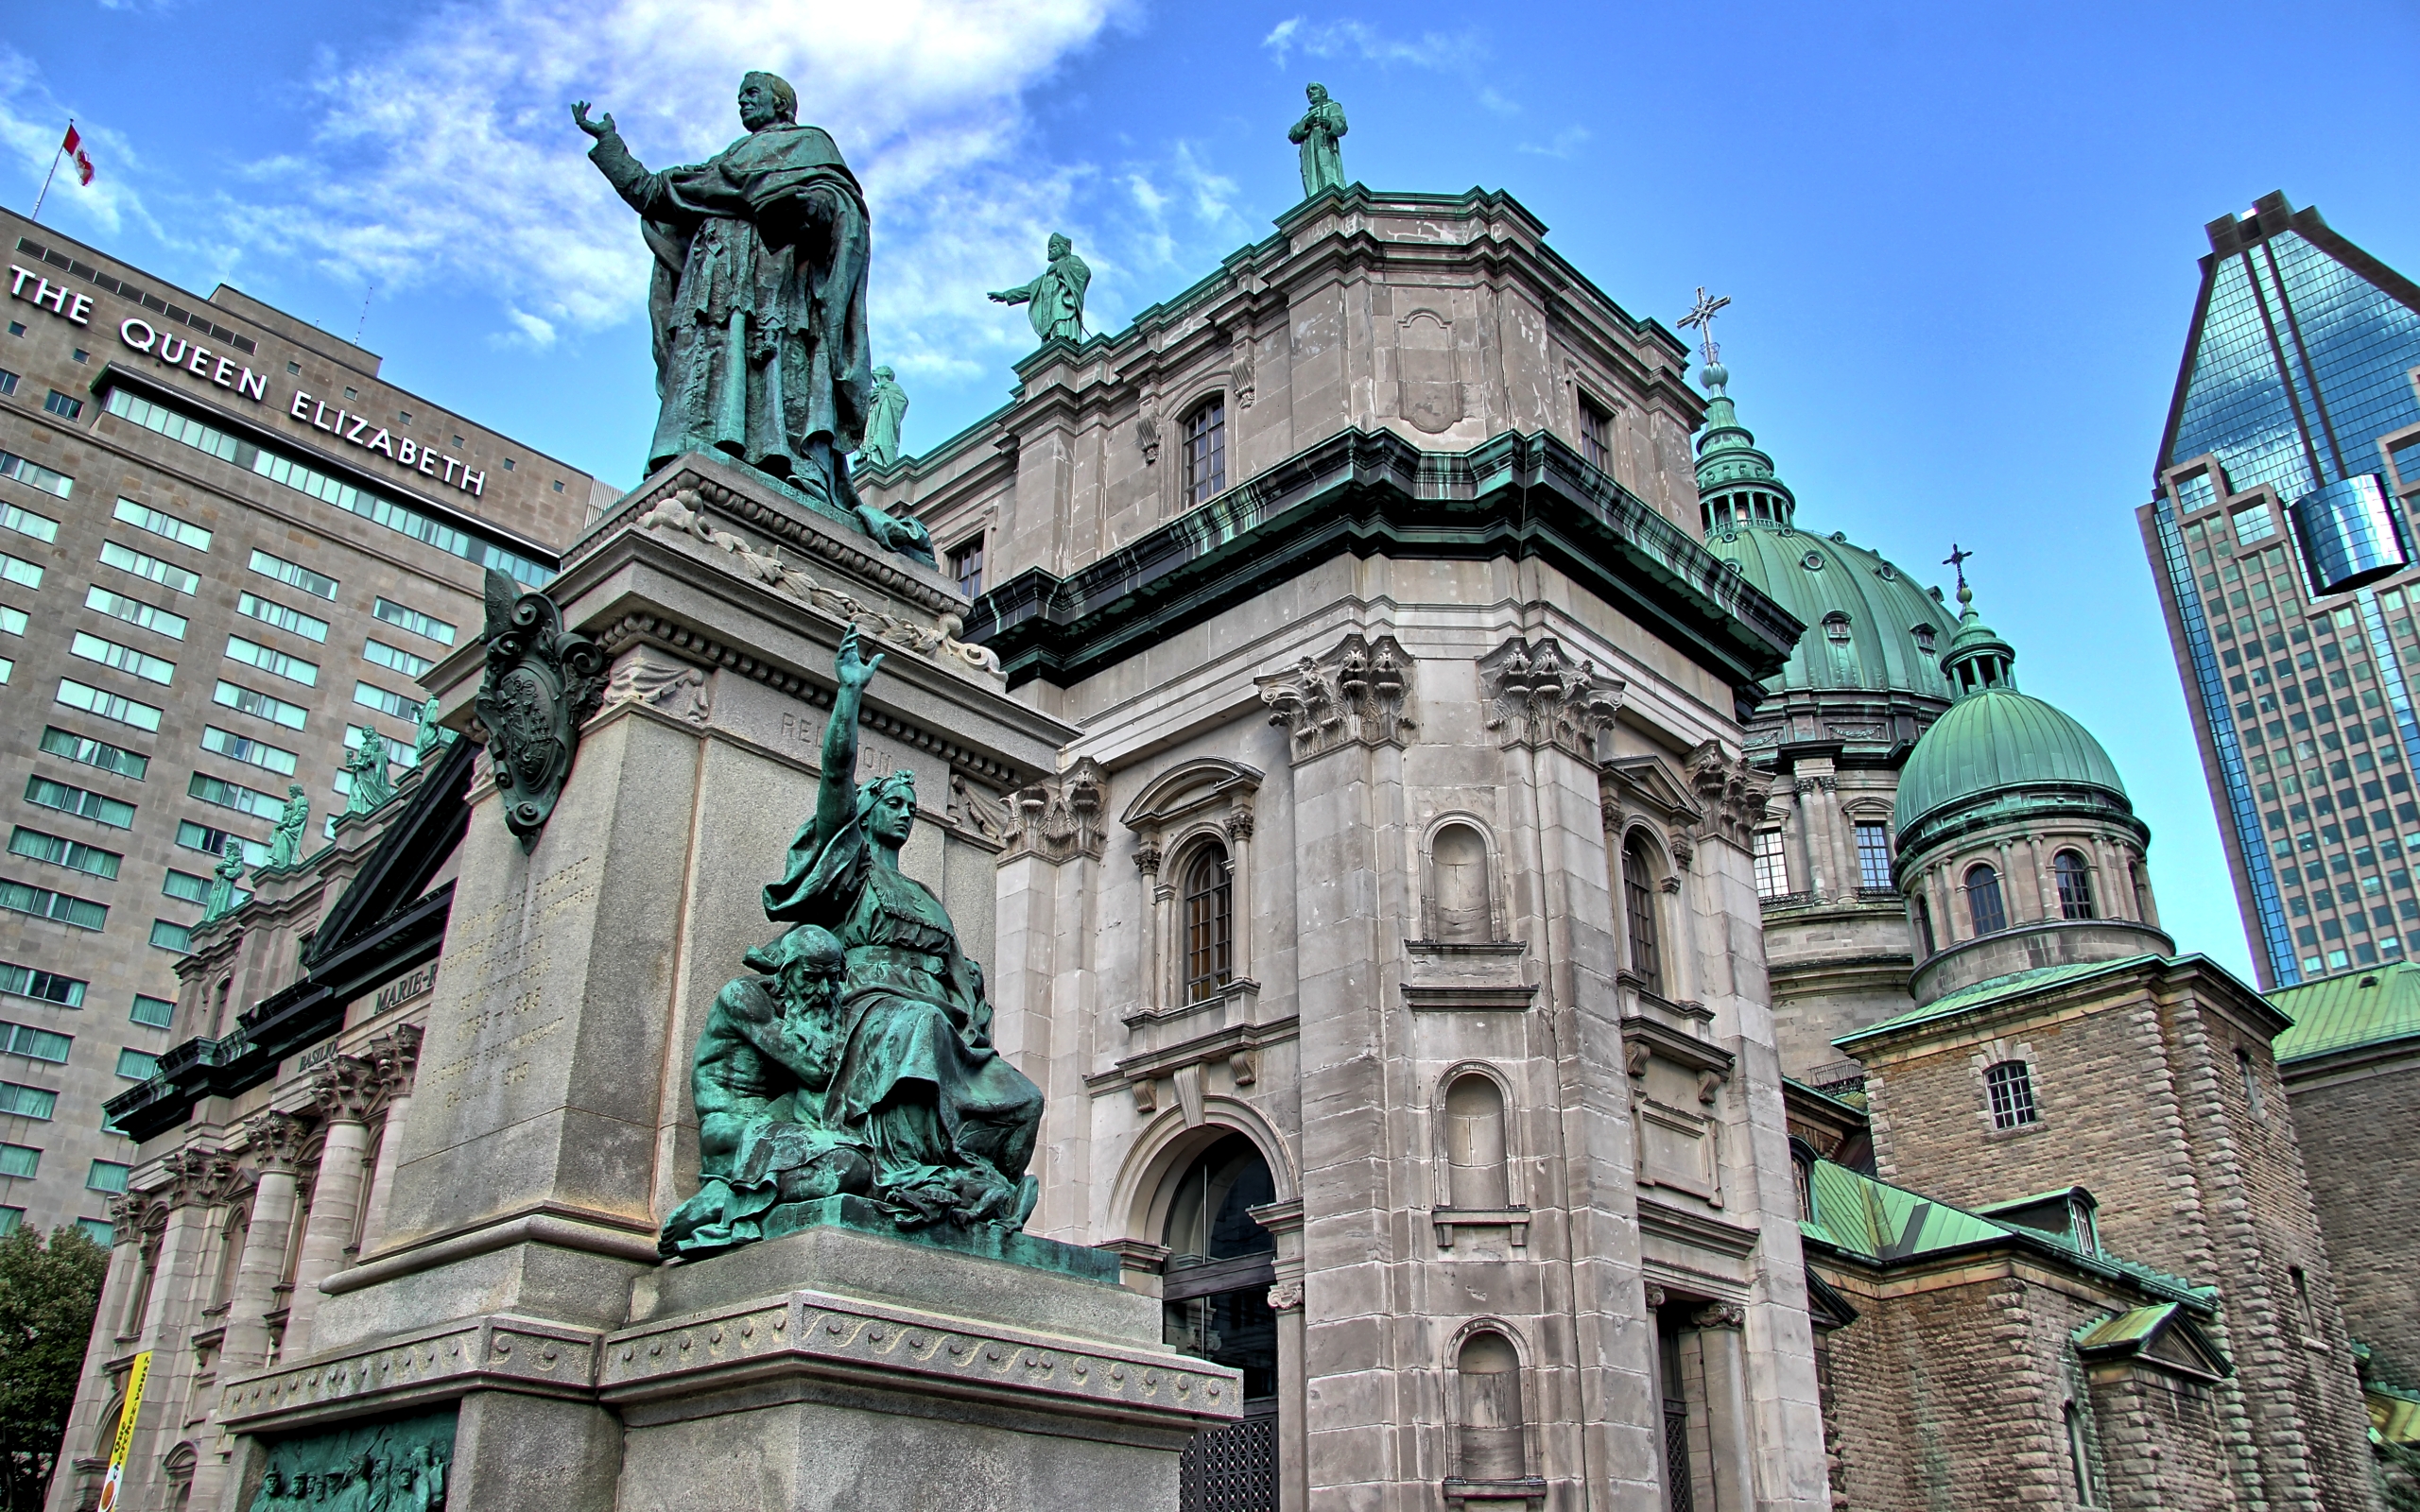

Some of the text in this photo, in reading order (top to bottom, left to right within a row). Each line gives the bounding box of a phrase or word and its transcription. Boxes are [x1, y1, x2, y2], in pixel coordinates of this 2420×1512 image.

[9, 264, 486, 497] THE QUEEN ELIZABETH
[781, 712, 892, 777] RELON
[112, 1356, 150, 1480] cherchez-vous?
[113, 1421, 126, 1454] Que
